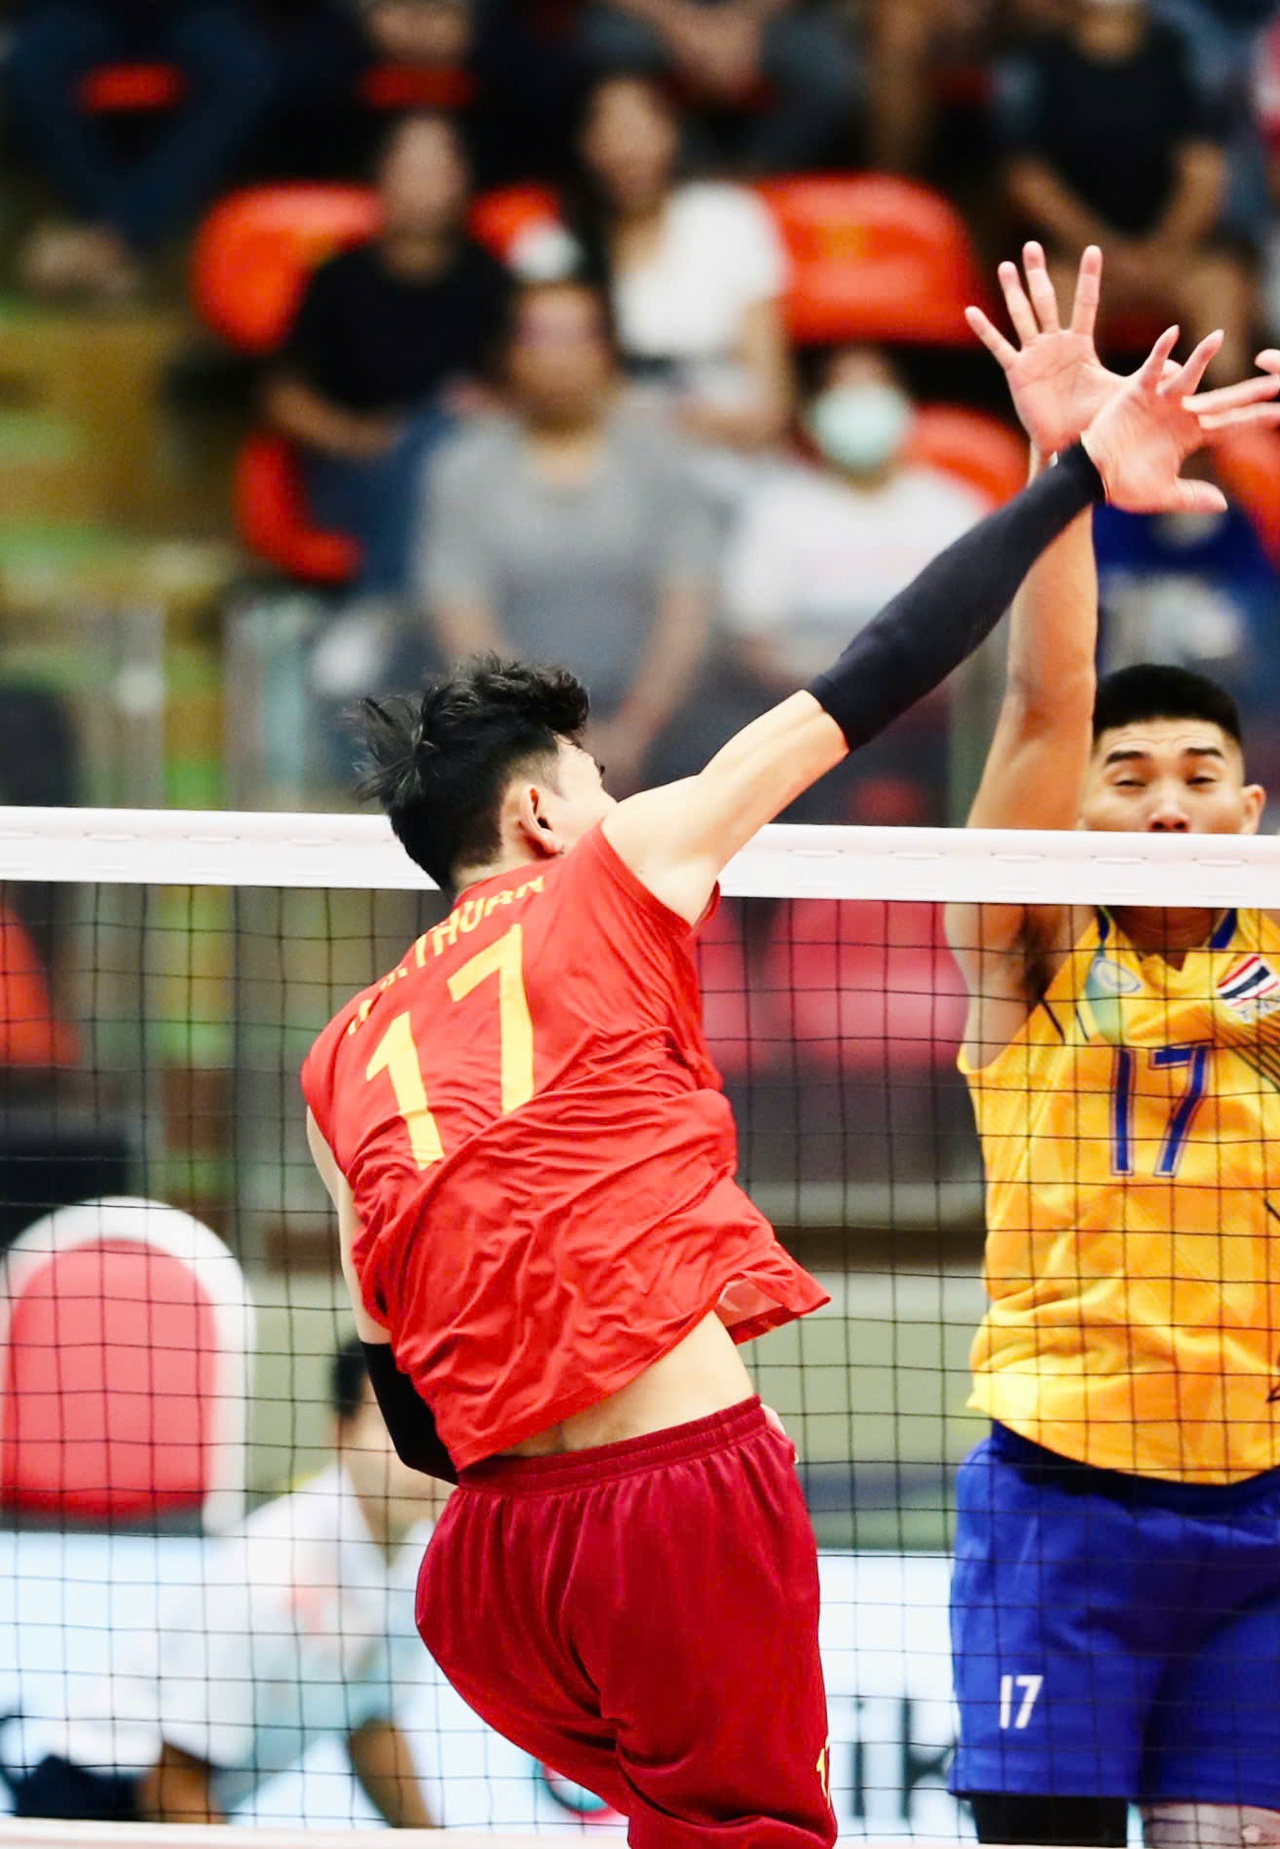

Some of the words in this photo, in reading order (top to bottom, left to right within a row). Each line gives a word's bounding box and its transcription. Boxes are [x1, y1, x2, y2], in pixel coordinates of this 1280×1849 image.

[364, 923, 535, 1171] 17
[1109, 1039, 1214, 1177] 17
[999, 1675, 1044, 1729] 17
